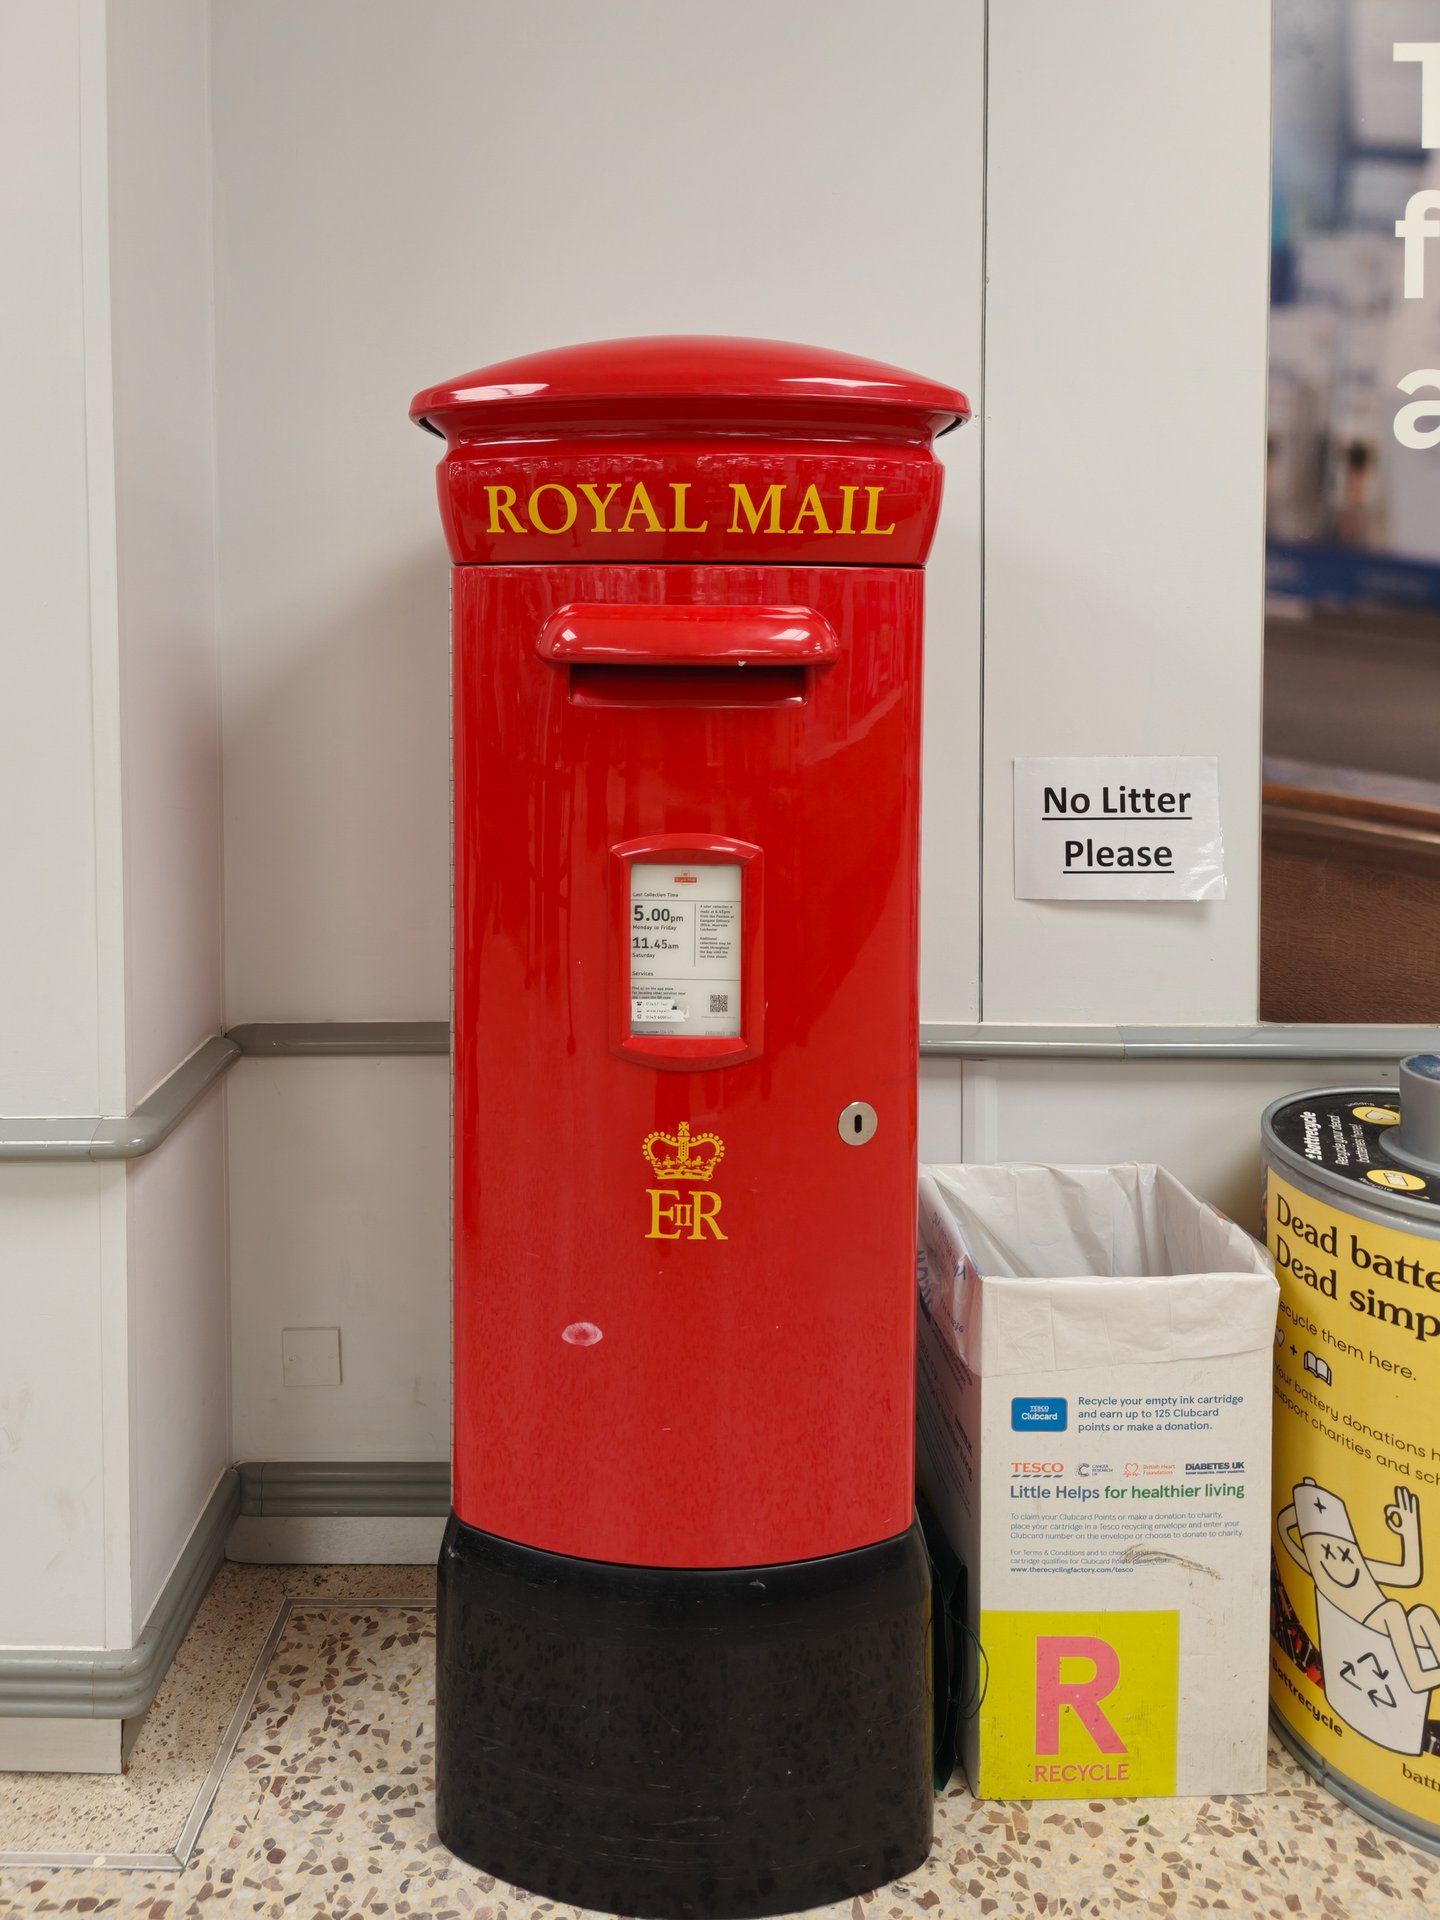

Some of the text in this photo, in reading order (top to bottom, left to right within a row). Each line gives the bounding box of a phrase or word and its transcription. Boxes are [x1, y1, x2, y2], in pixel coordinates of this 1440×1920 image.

[483, 481, 896, 535] ROYAL MAIL
[1044, 785, 1192, 813] No Litter
[1065, 838, 1172, 867] Please
[633, 905, 684, 923] 5.00pm
[632, 936, 679, 950] 11.45am
[1327, 1114, 1343, 1131] dead
[1300, 1111, 1322, 1157] Battrecycle
[1331, 1143, 1350, 1166] Recycle
[1277, 1193, 1440, 1293] Dead batte
[1276, 1234, 1440, 1342] Dead simp
[1278, 1300, 1417, 1381] ecycle them here.
[1078, 1394, 1244, 1407] Recycle your empty ink cartridge
[1021, 1412, 1058, 1421] Clubcard
[1078, 1410, 1097, 1419] and
[1125, 1410, 1139, 1420] up
[1155, 1409, 1171, 1418] 125
[1173, 1408, 1219, 1417] Clubcard
[1295, 1379, 1338, 1422] battery
[1342, 1415, 1426, 1458] donations
[1078, 1422, 1111, 1433] points
[1113, 1424, 1125, 1432] or
[1126, 1423, 1154, 1431] make
[1164, 1421, 1213, 1431] donation.
[1311, 1416, 1372, 1460] charities
[1376, 1454, 1410, 1476] and
[1010, 1462, 1064, 1473] TESCO
[1231, 1461, 1245, 1470] UK
[1010, 1483, 1245, 1502] Little Helps for healthier living
[1010, 1523, 1030, 1531] place
[1049, 1523, 1084, 1531] cartridge
[1121, 1523, 1153, 1531] recycling
[1154, 1522, 1187, 1530] envelope
[1045, 1532, 1073, 1540] number
[1182, 1530, 1207, 1538] donate
[1010, 1558, 1040, 1566] cartridge
[1010, 1566, 1134, 1574] www.therecyclingfactory.com/tesco
[1035, 1635, 1129, 1756] R
[1272, 1657, 1343, 1738] Battrecycle
[1034, 1763, 1129, 1782] RECYCLE
